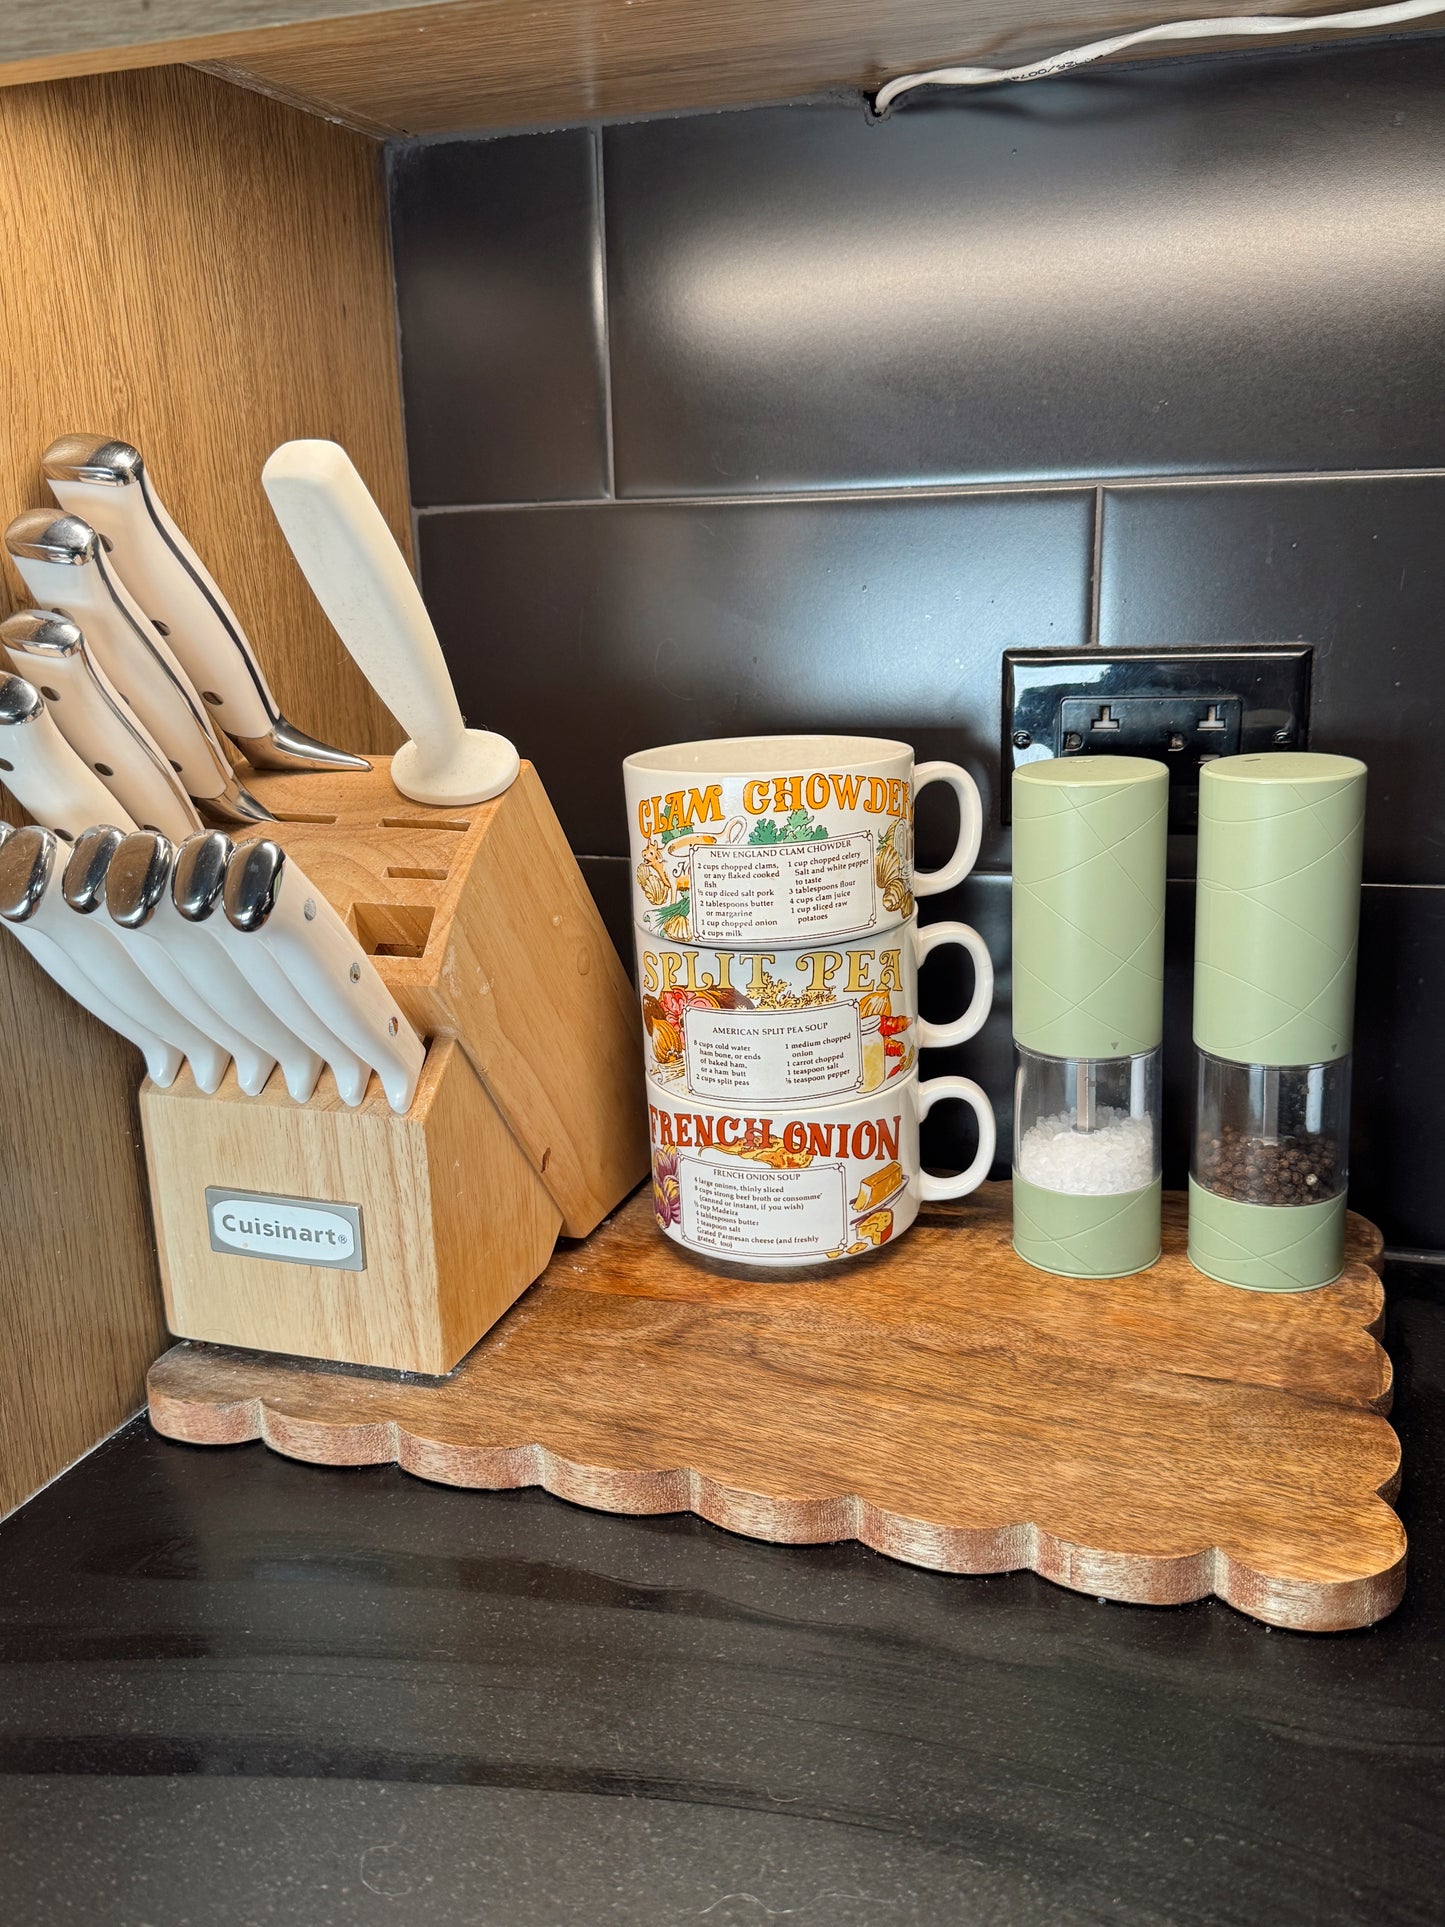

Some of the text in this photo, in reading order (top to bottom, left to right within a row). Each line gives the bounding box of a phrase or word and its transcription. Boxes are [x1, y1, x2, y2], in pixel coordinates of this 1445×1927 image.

[638, 784, 726, 839] CLAM
[733, 849, 777, 858] ENGLAND
[779, 847, 805, 856] CLAM
[807, 840, 851, 853] CHOWDER
[794, 860, 808, 868] cup
[810, 854, 840, 865] chopped
[842, 851, 861, 860] celery
[703, 863, 719, 871] cups
[721, 863, 752, 871] chopped
[794, 859, 869, 876] Salt and white pepper
[795, 883, 839, 894] tablespoons
[840, 880, 856, 888] flour
[757, 889, 774, 898] pork
[834, 890, 851, 900] juice
[706, 900, 749, 909] tablespoons
[797, 906, 811, 914] cup
[812, 902, 833, 912] sliced
[715, 910, 753, 918] margarine
[798, 914, 828, 924] potatoes
[721, 920, 753, 928] chopped
[707, 930, 724, 938] cups
[643, 949, 903, 992] SPLIT PEA
[712, 1027, 759, 1035] AMERICAN
[787, 1026, 803, 1034] PEA
[805, 1022, 828, 1032] SOUP
[699, 1041, 713, 1049] cups
[791, 1041, 821, 1049] medium
[823, 1032, 851, 1045] chopped
[699, 1048, 713, 1057] ham
[792, 1050, 813, 1058] onion
[708, 1058, 728, 1067] baked
[793, 1059, 813, 1067] carrot
[815, 1052, 844, 1063] chopped
[715, 1067, 729, 1075] ham
[793, 1066, 825, 1075] teaspoon
[701, 1075, 716, 1083] cups
[717, 1078, 733, 1086] split
[794, 1074, 825, 1084] teaspoon
[827, 1069, 850, 1080] pepper
[649, 1104, 902, 1160] FRENCH ONION
[713, 1169, 744, 1179] FRENCH
[699, 1177, 713, 1187] large
[740, 1185, 762, 1193] thinly
[699, 1187, 713, 1195] cups
[714, 1190, 735, 1200] strong
[736, 1193, 750, 1201] beef
[712, 1206, 738, 1216] Madeira
[700, 1211, 737, 1224] tablespoons
[738, 1218, 759, 1226] butter
[701, 1220, 727, 1231] teaspoon
[697, 1226, 716, 1237] Grated
[718, 1232, 750, 1243] Parmesan
[751, 1236, 774, 1244] cheese
[794, 1235, 819, 1244] freshly
